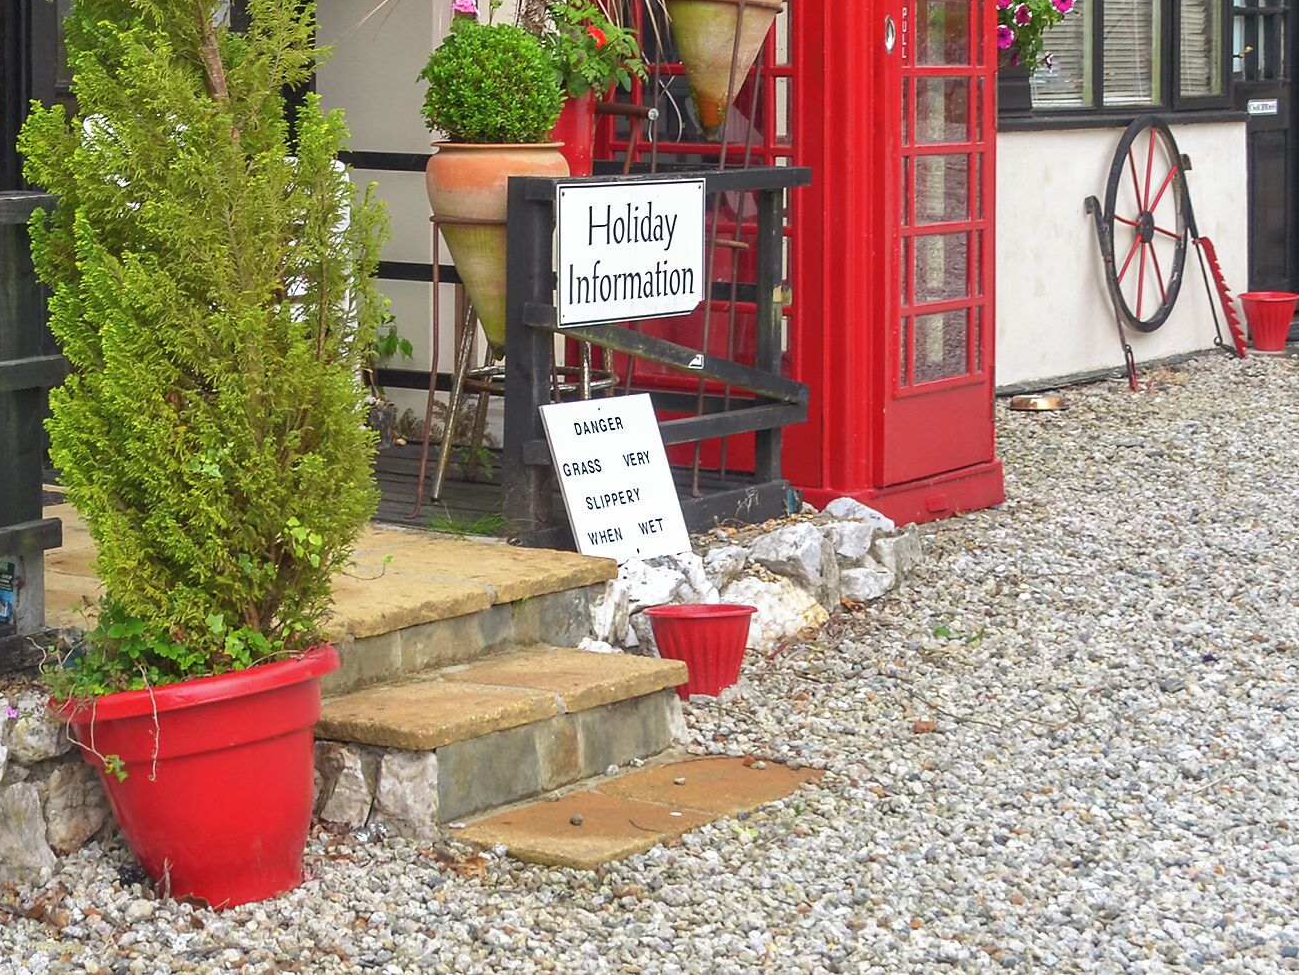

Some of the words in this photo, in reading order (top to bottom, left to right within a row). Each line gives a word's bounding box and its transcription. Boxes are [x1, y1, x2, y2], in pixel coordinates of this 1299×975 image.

[588, 201, 678, 251] Holiday
[569, 259, 695, 305] Information
[573, 416, 624, 436] DANGER
[562, 458, 602, 477] GRASS
[622, 450, 651, 467] VERY
[585, 487, 641, 510] SLIPPERY
[588, 527, 623, 546] WHEN
[638, 518, 664, 535] WET
